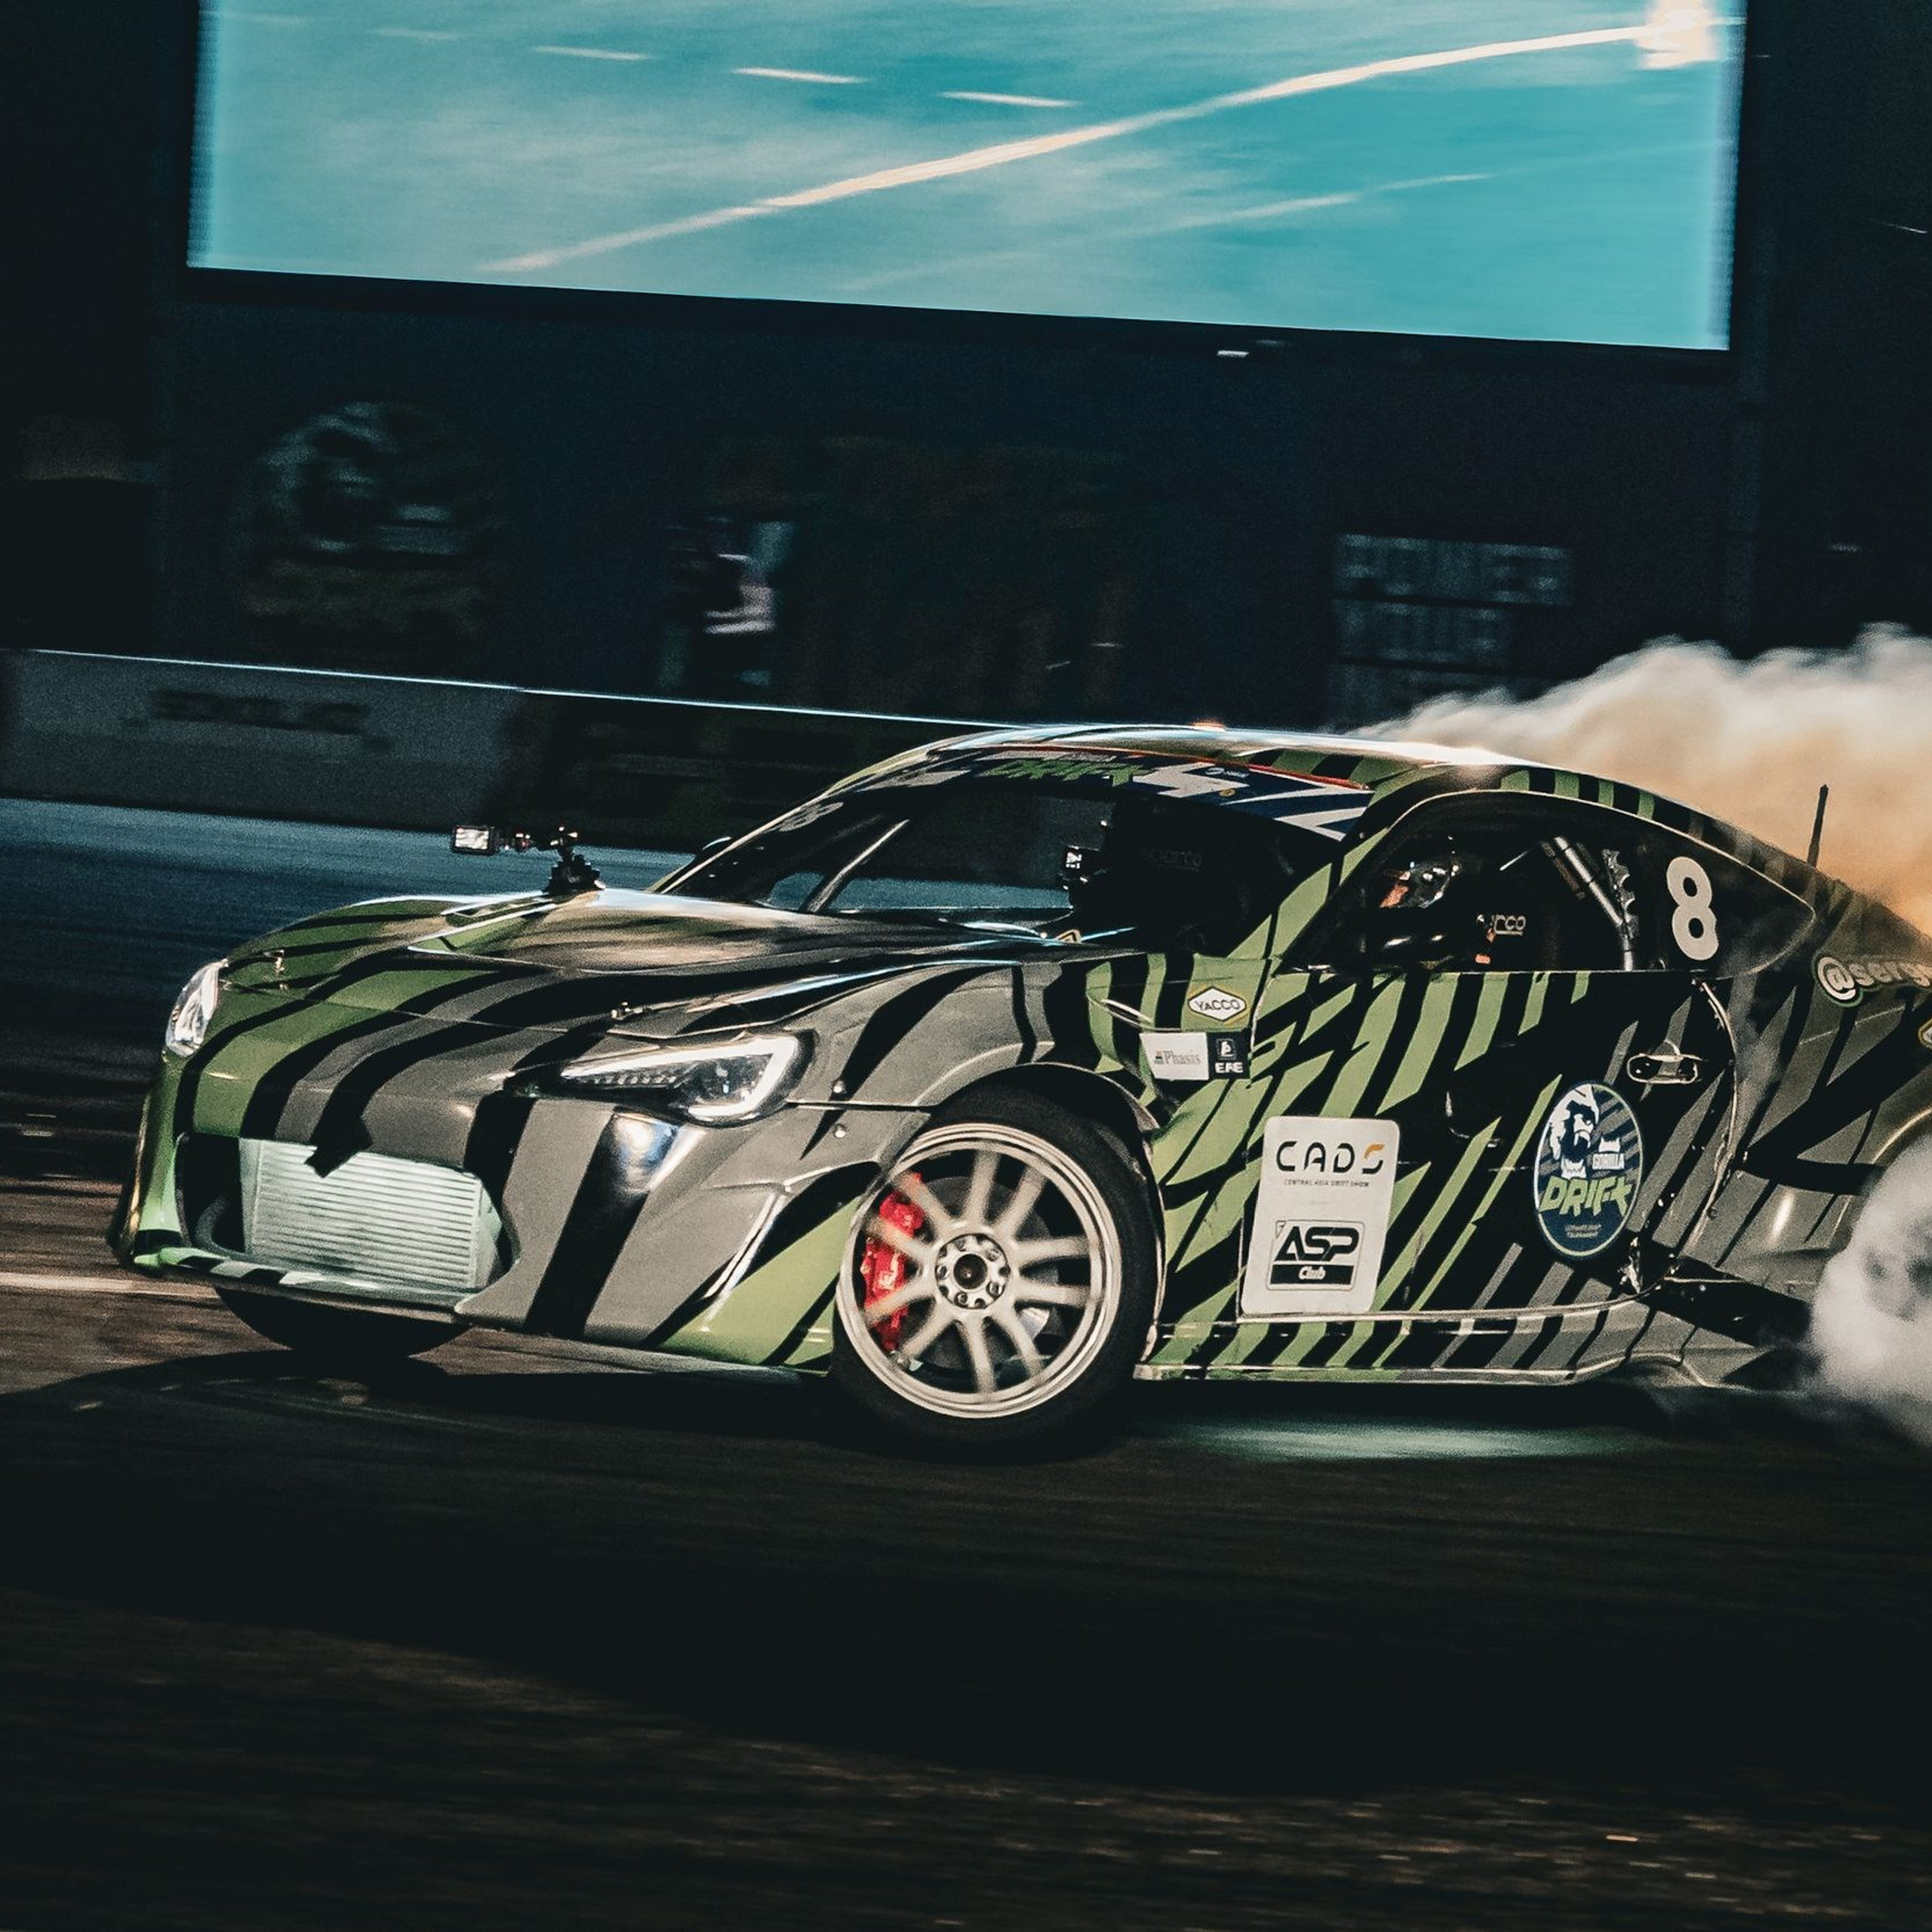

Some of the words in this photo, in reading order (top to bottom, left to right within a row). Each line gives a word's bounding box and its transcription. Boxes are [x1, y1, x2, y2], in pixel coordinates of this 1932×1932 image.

[1666, 856, 1719, 961] 8
[1195, 998, 1240, 1011] YACCO
[1163, 1050, 1201, 1065] Phasis
[1275, 1140, 1385, 1174] CADS
[1539, 1175, 1632, 1217] DRIFT
[1273, 1226, 1360, 1262] ASP
